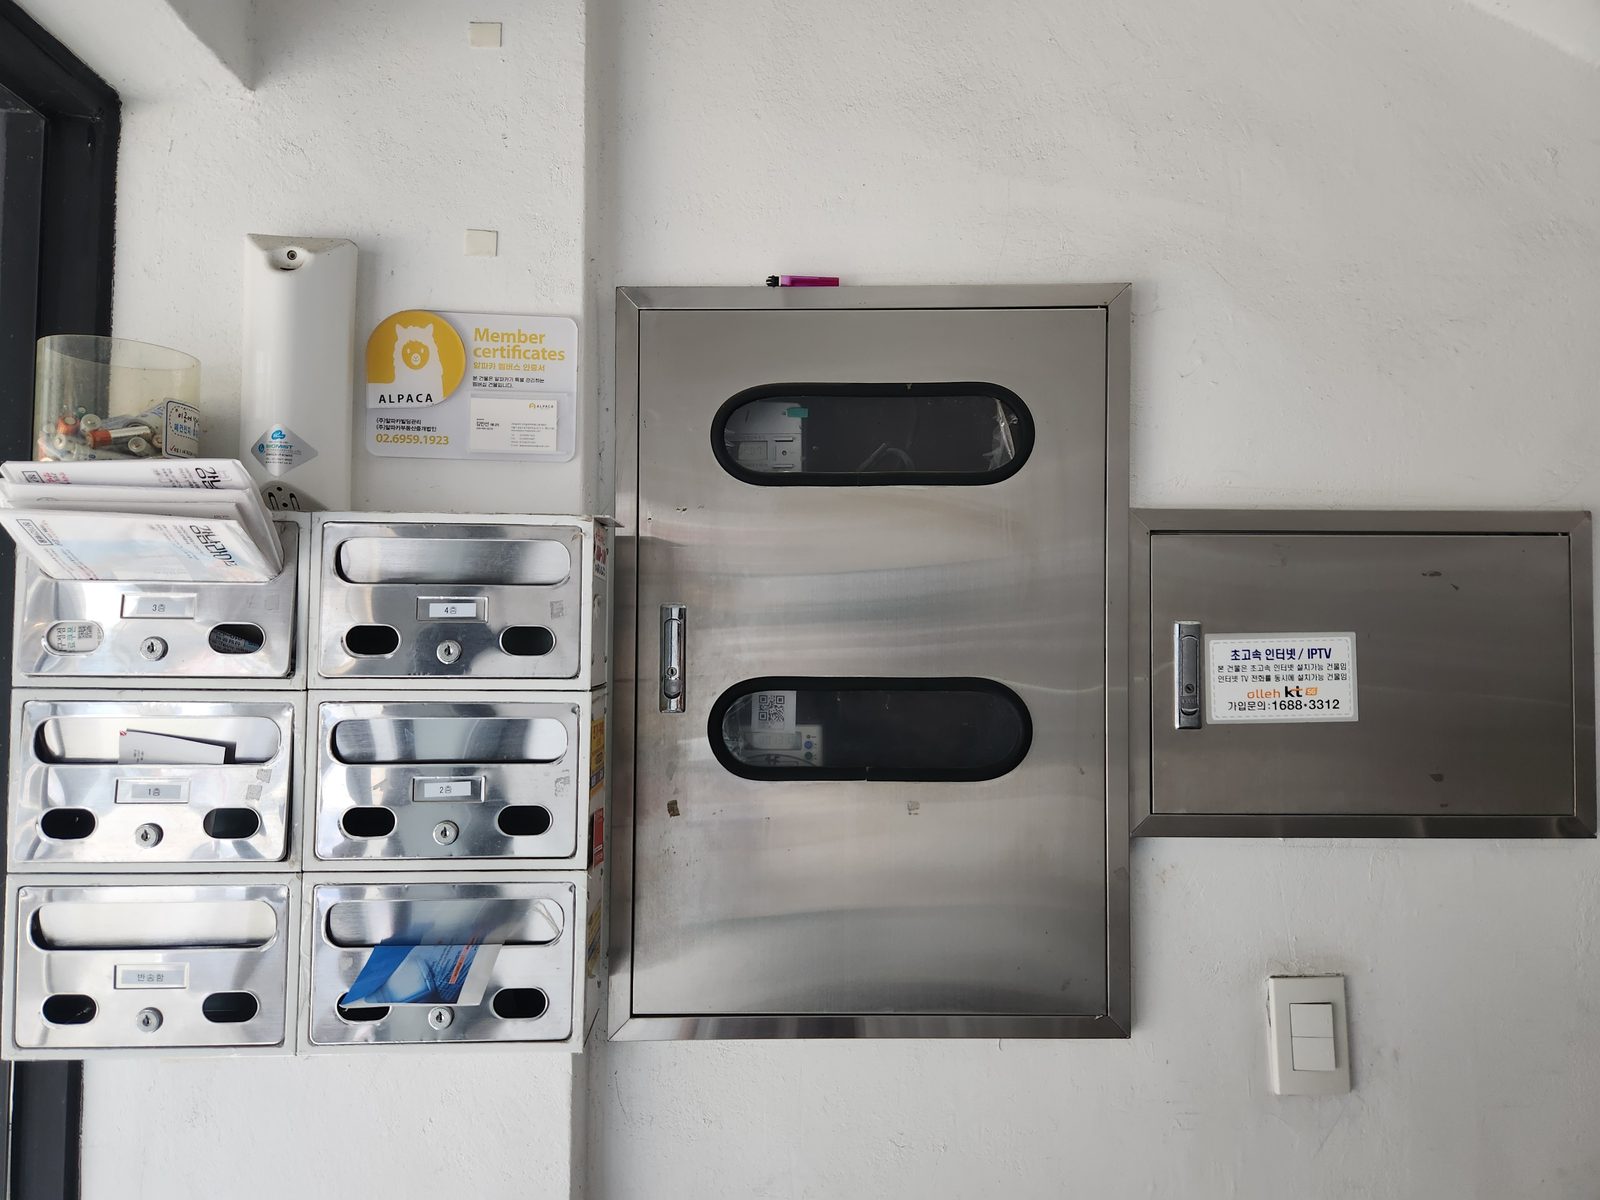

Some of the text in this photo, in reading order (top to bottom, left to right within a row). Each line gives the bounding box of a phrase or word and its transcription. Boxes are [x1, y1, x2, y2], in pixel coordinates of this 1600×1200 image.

[474, 328, 546, 344] Member
[473, 345, 565, 361] certificates
[473, 361, 496, 370] 알파카
[523, 363, 545, 372] 인증서
[379, 393, 433, 404] ALPACA
[376, 417, 422, 425] (주)알파카빌딩관리
[376, 433, 449, 445] 02.6959.1923
[152, 604, 166, 613] 3층
[1231, 649, 1262, 661] 초고속
[1307, 648, 1332, 660] IPTV
[1217, 662, 1347, 673] 본 건물은 초고속 인터넷 설치가능 건물임
[1217, 675, 1239, 683] 인터넷
[1241, 675, 1249, 683] TV
[1274, 674, 1294, 682] 동시에
[1327, 673, 1348, 681] 건물임
[1247, 688, 1281, 699] olleh
[1284, 686, 1303, 698] kt
[148, 788, 161, 796] 1층
[439, 786, 452, 794] 2층
[137, 973, 164, 982] 반송함
